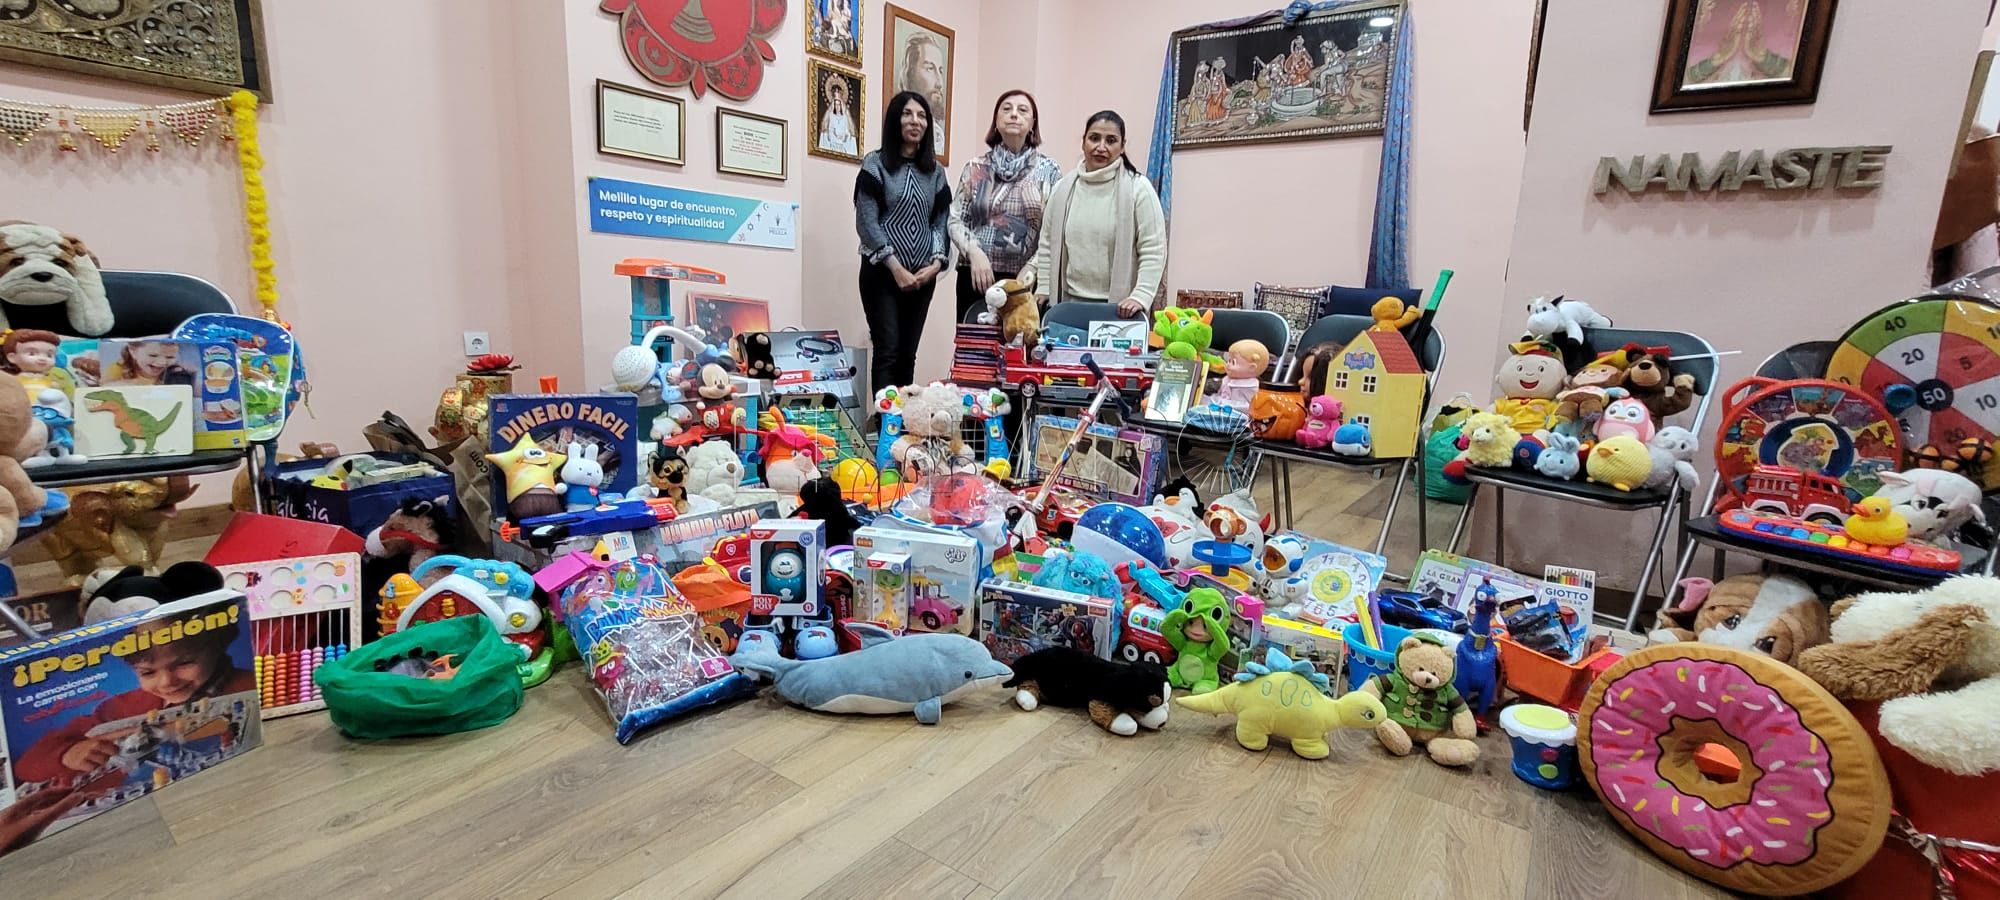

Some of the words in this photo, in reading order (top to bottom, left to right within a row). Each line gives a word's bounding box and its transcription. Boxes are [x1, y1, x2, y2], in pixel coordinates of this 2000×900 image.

[1594, 145, 1893, 194] NAMASTE
[599, 190, 637, 204] Melilla
[640, 194, 668, 211] lugar
[670, 201, 684, 210] de
[685, 205, 738, 217] encuentro,
[600, 208, 645, 222] respeto
[646, 215, 653, 224] y
[655, 214, 725, 229] espiritualidad
[1884, 316, 1907, 332] 40
[1901, 348, 1925, 366] 20
[1922, 388, 1947, 405] 50
[1975, 394, 1998, 411] 10
[496, 402, 574, 444] DINERO
[577, 403, 630, 441] FACIL
[722, 510, 760, 532] FLOTA
[613, 536, 628, 547] MB
[1545, 587, 1589, 601] GIOTTO
[12, 604, 239, 688] ¡Perdición!
[77, 682, 99, 694] con
[16, 695, 34, 705] La
